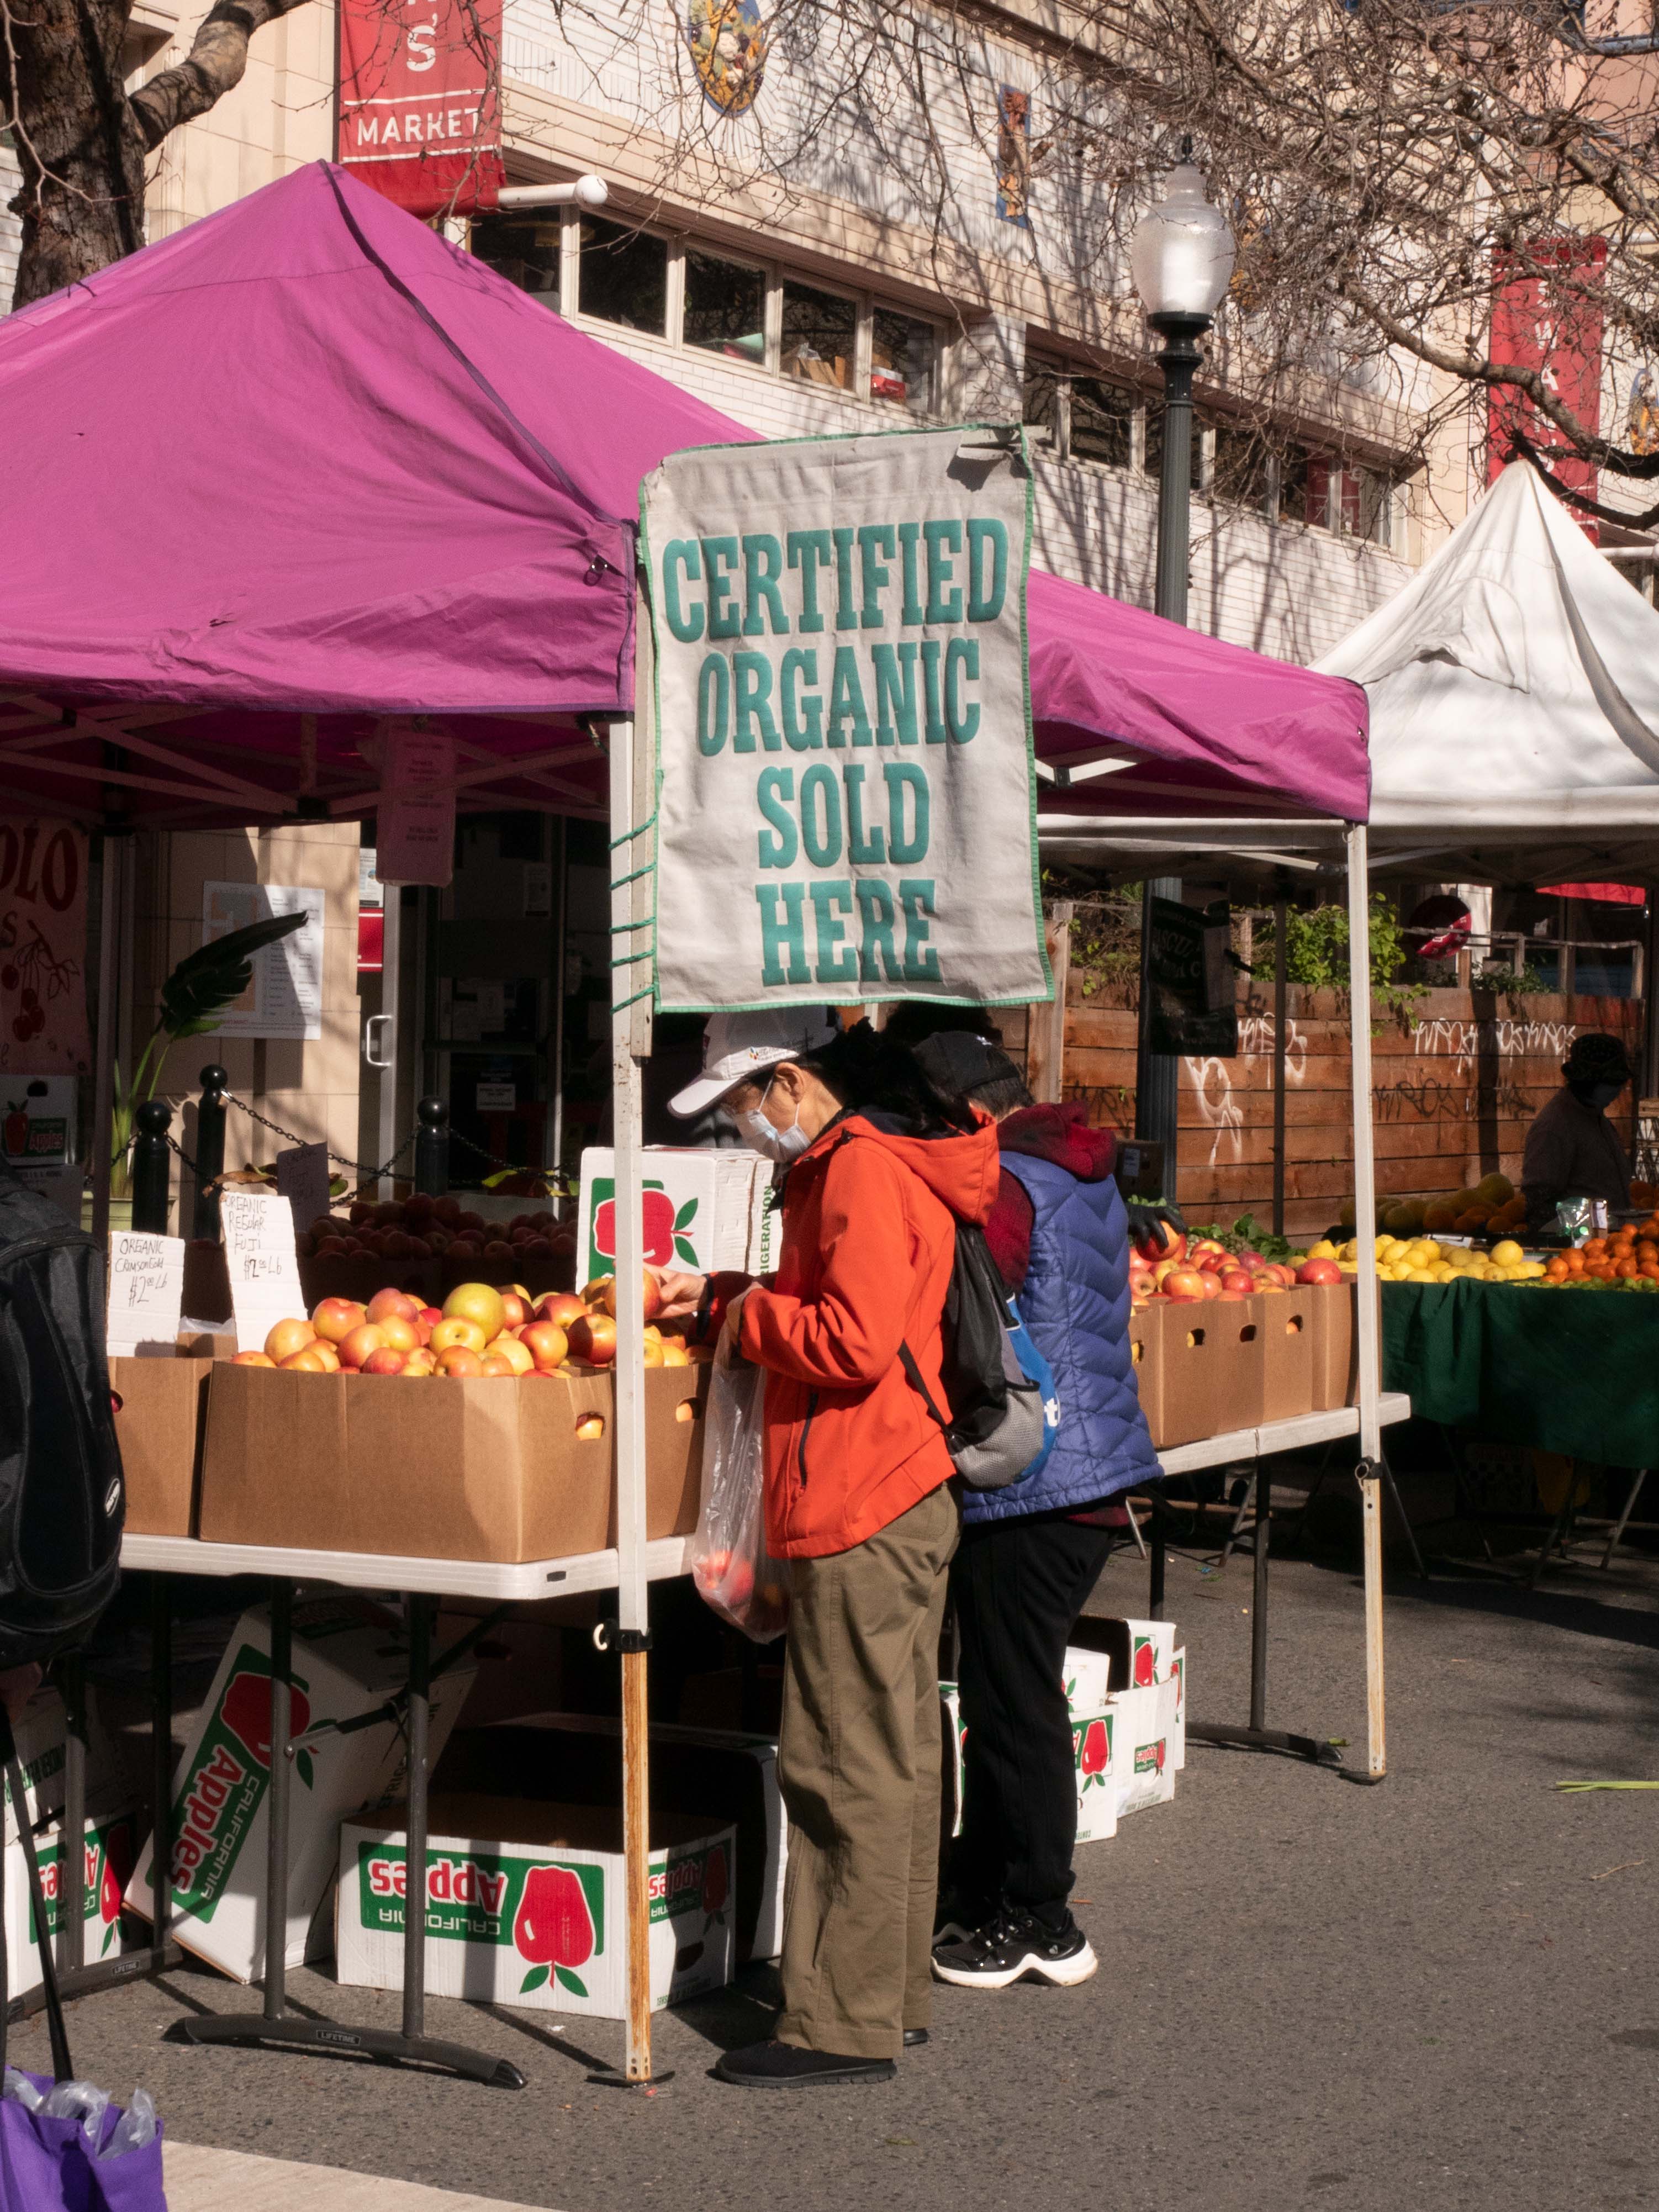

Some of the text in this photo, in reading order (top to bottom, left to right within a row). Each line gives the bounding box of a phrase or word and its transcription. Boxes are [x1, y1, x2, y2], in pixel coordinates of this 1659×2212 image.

[357, 108, 484, 146] MARKET
[662, 518, 1009, 643] CERTIFIED
[697, 637, 981, 757] ORGANIC
[756, 762, 931, 869] SOLD
[754, 879, 943, 987] HERE
[225, 1194, 267, 1214] ORGANIC
[120, 1239, 164, 1255] ORGANIC
[170, 1744, 248, 1894] Apples
[200, 1775, 260, 1900] CALIFORNIA
[367, 1857, 509, 1917] Appes
[378, 1908, 500, 1936] CALIFONIA
[114, 1961, 138, 1975] LIFETIME
[321, 2030, 358, 2044] LIFETIME
